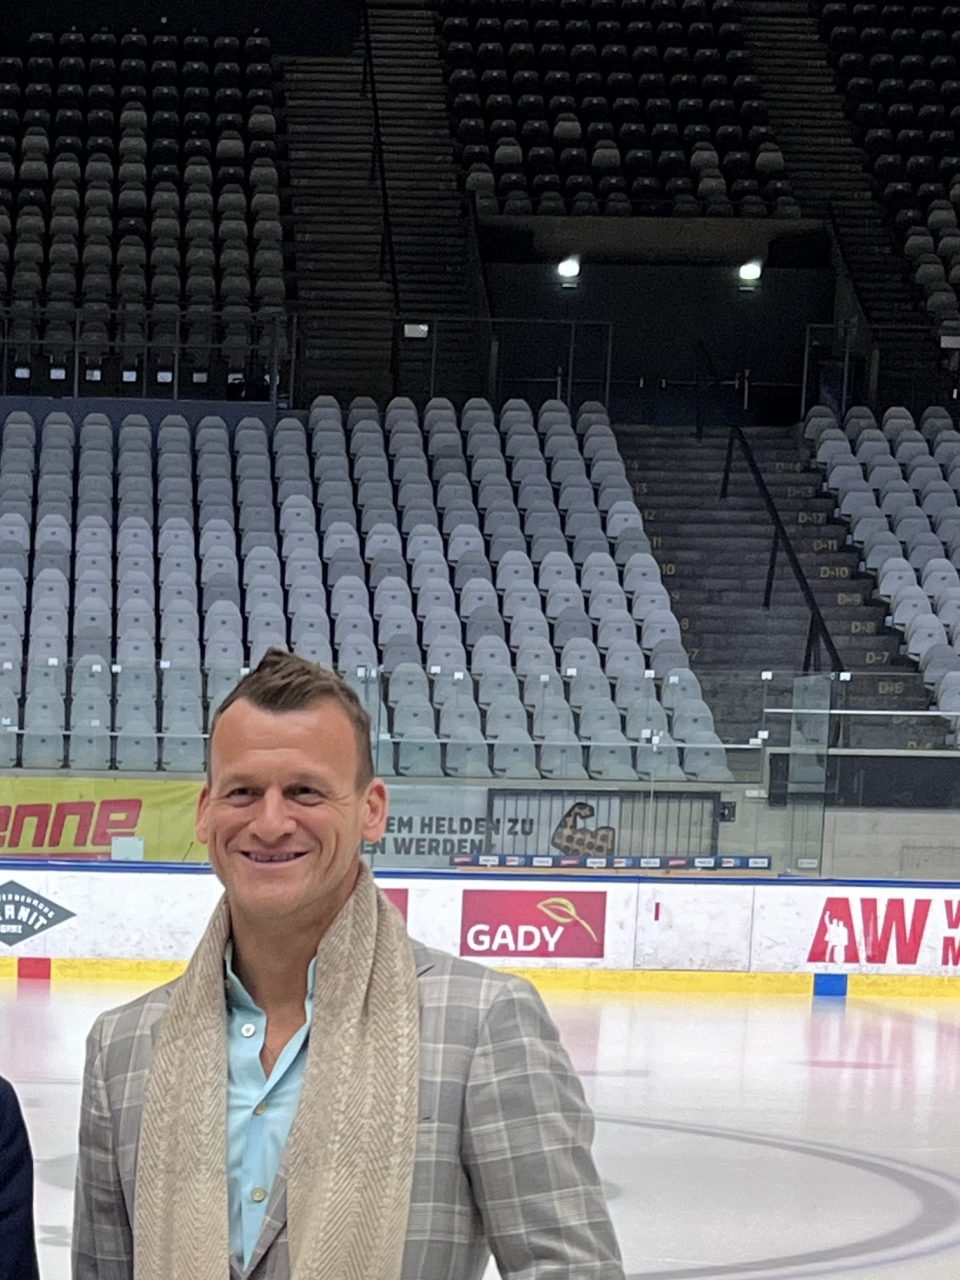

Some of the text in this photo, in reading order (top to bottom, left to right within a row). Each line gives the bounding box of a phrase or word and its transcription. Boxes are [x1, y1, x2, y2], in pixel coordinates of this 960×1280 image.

[819, 566, 849, 578] D-10
[865, 651, 890, 664] D-7
[420, 816, 500, 836] HELDEN
[507, 818, 533, 837] ZU
[466, 924, 564, 952] GADY
[807, 897, 932, 965] AW
